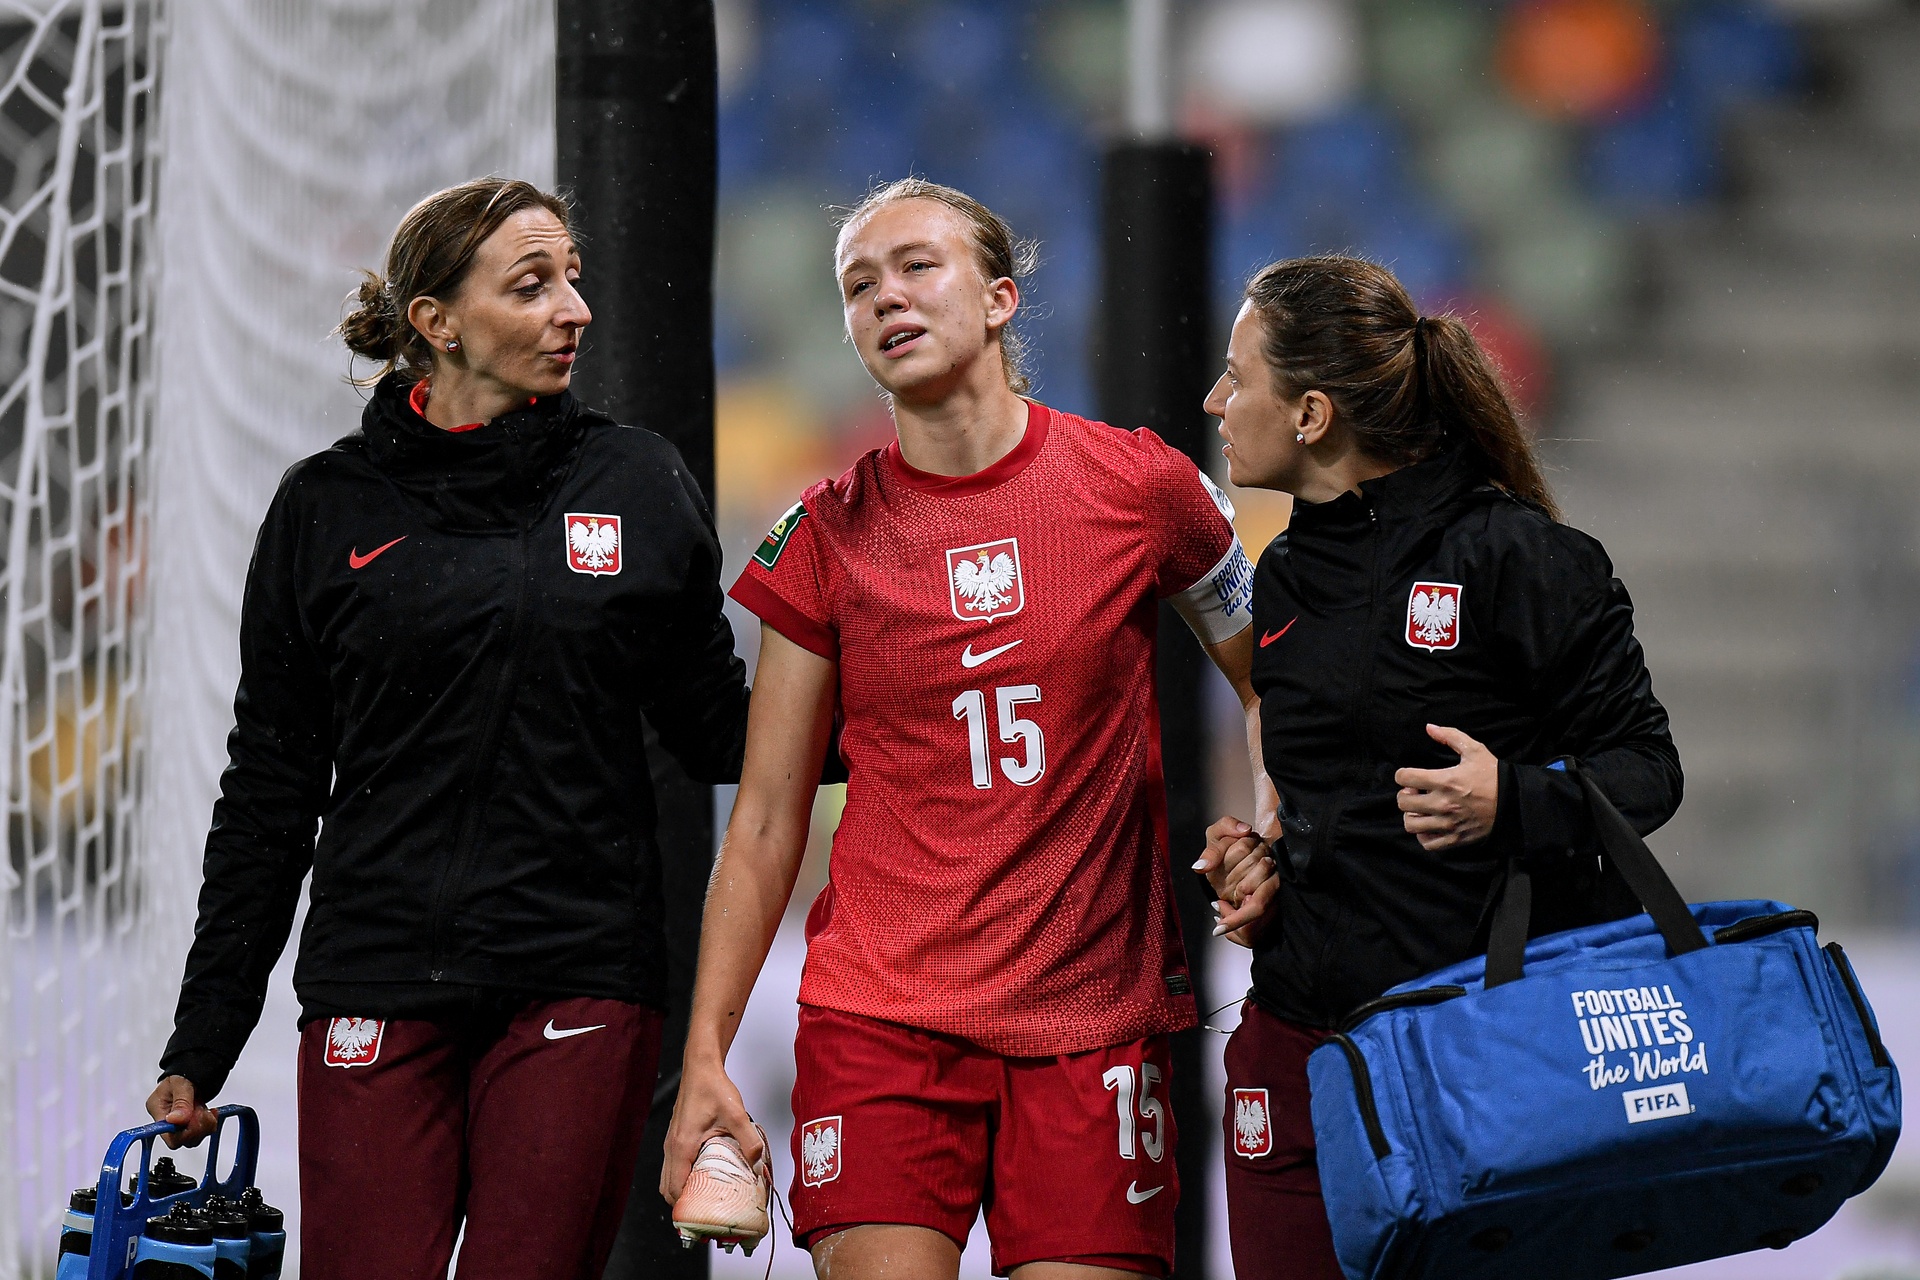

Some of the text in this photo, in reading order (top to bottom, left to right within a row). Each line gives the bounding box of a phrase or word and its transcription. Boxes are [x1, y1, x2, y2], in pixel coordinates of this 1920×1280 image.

[1222, 597, 1242, 617] the
[952, 684, 1046, 789] 15
[1571, 985, 1683, 1018] FOOTBALL
[1579, 1009, 1694, 1055] UNITES
[1582, 1042, 1709, 1090] the World
[1102, 1062, 1164, 1163] 15
[1634, 1093, 1680, 1113] FIFA
